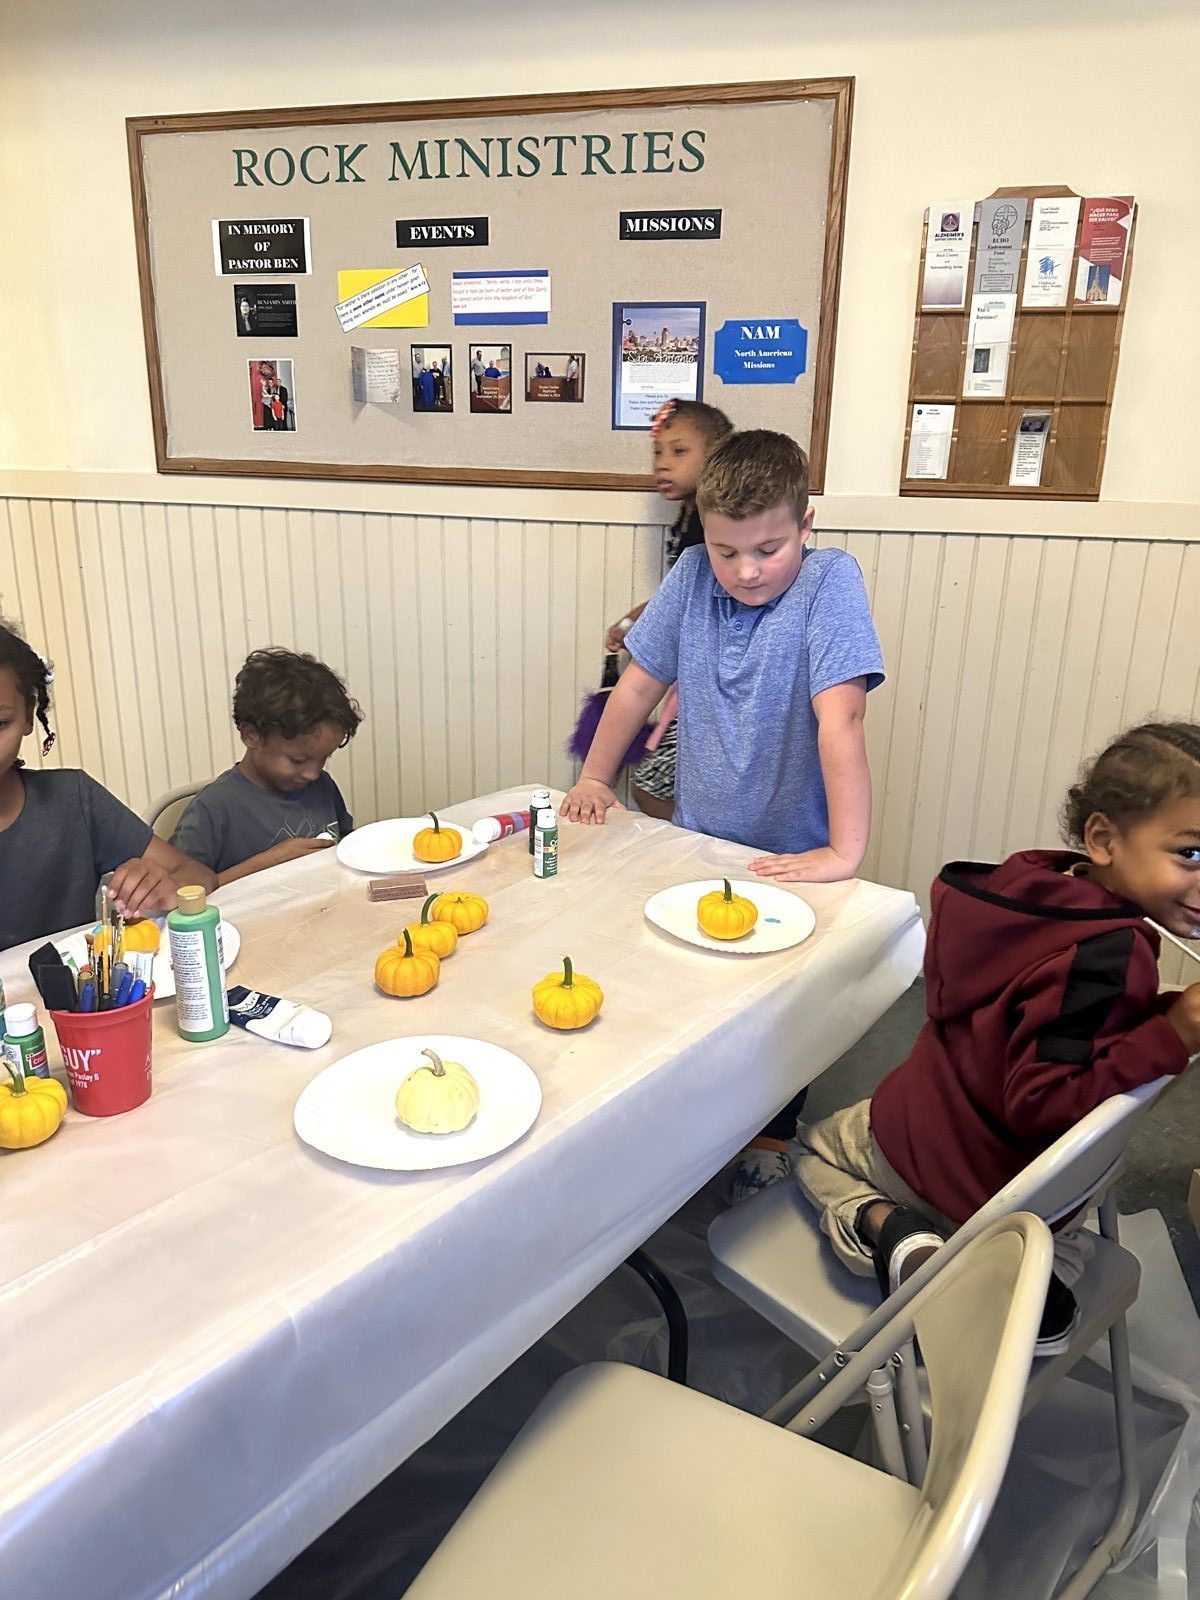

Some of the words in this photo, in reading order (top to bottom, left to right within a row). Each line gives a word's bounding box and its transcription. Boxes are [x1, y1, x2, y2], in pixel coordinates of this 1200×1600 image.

[232, 143, 368, 186] ROCK
[388, 130, 706, 181] MINISTRIES
[228, 225, 241, 235] IN
[243, 224, 295, 234] MEMORY
[625, 216, 715, 232] MISSIONS
[410, 224, 475, 240] EVENTS
[254, 241, 270, 252] OF
[228, 259, 272, 269] PASTOR
[274, 258, 298, 269] BEN
[740, 326, 781, 340] NAM
[628, 350, 648, 362] San
